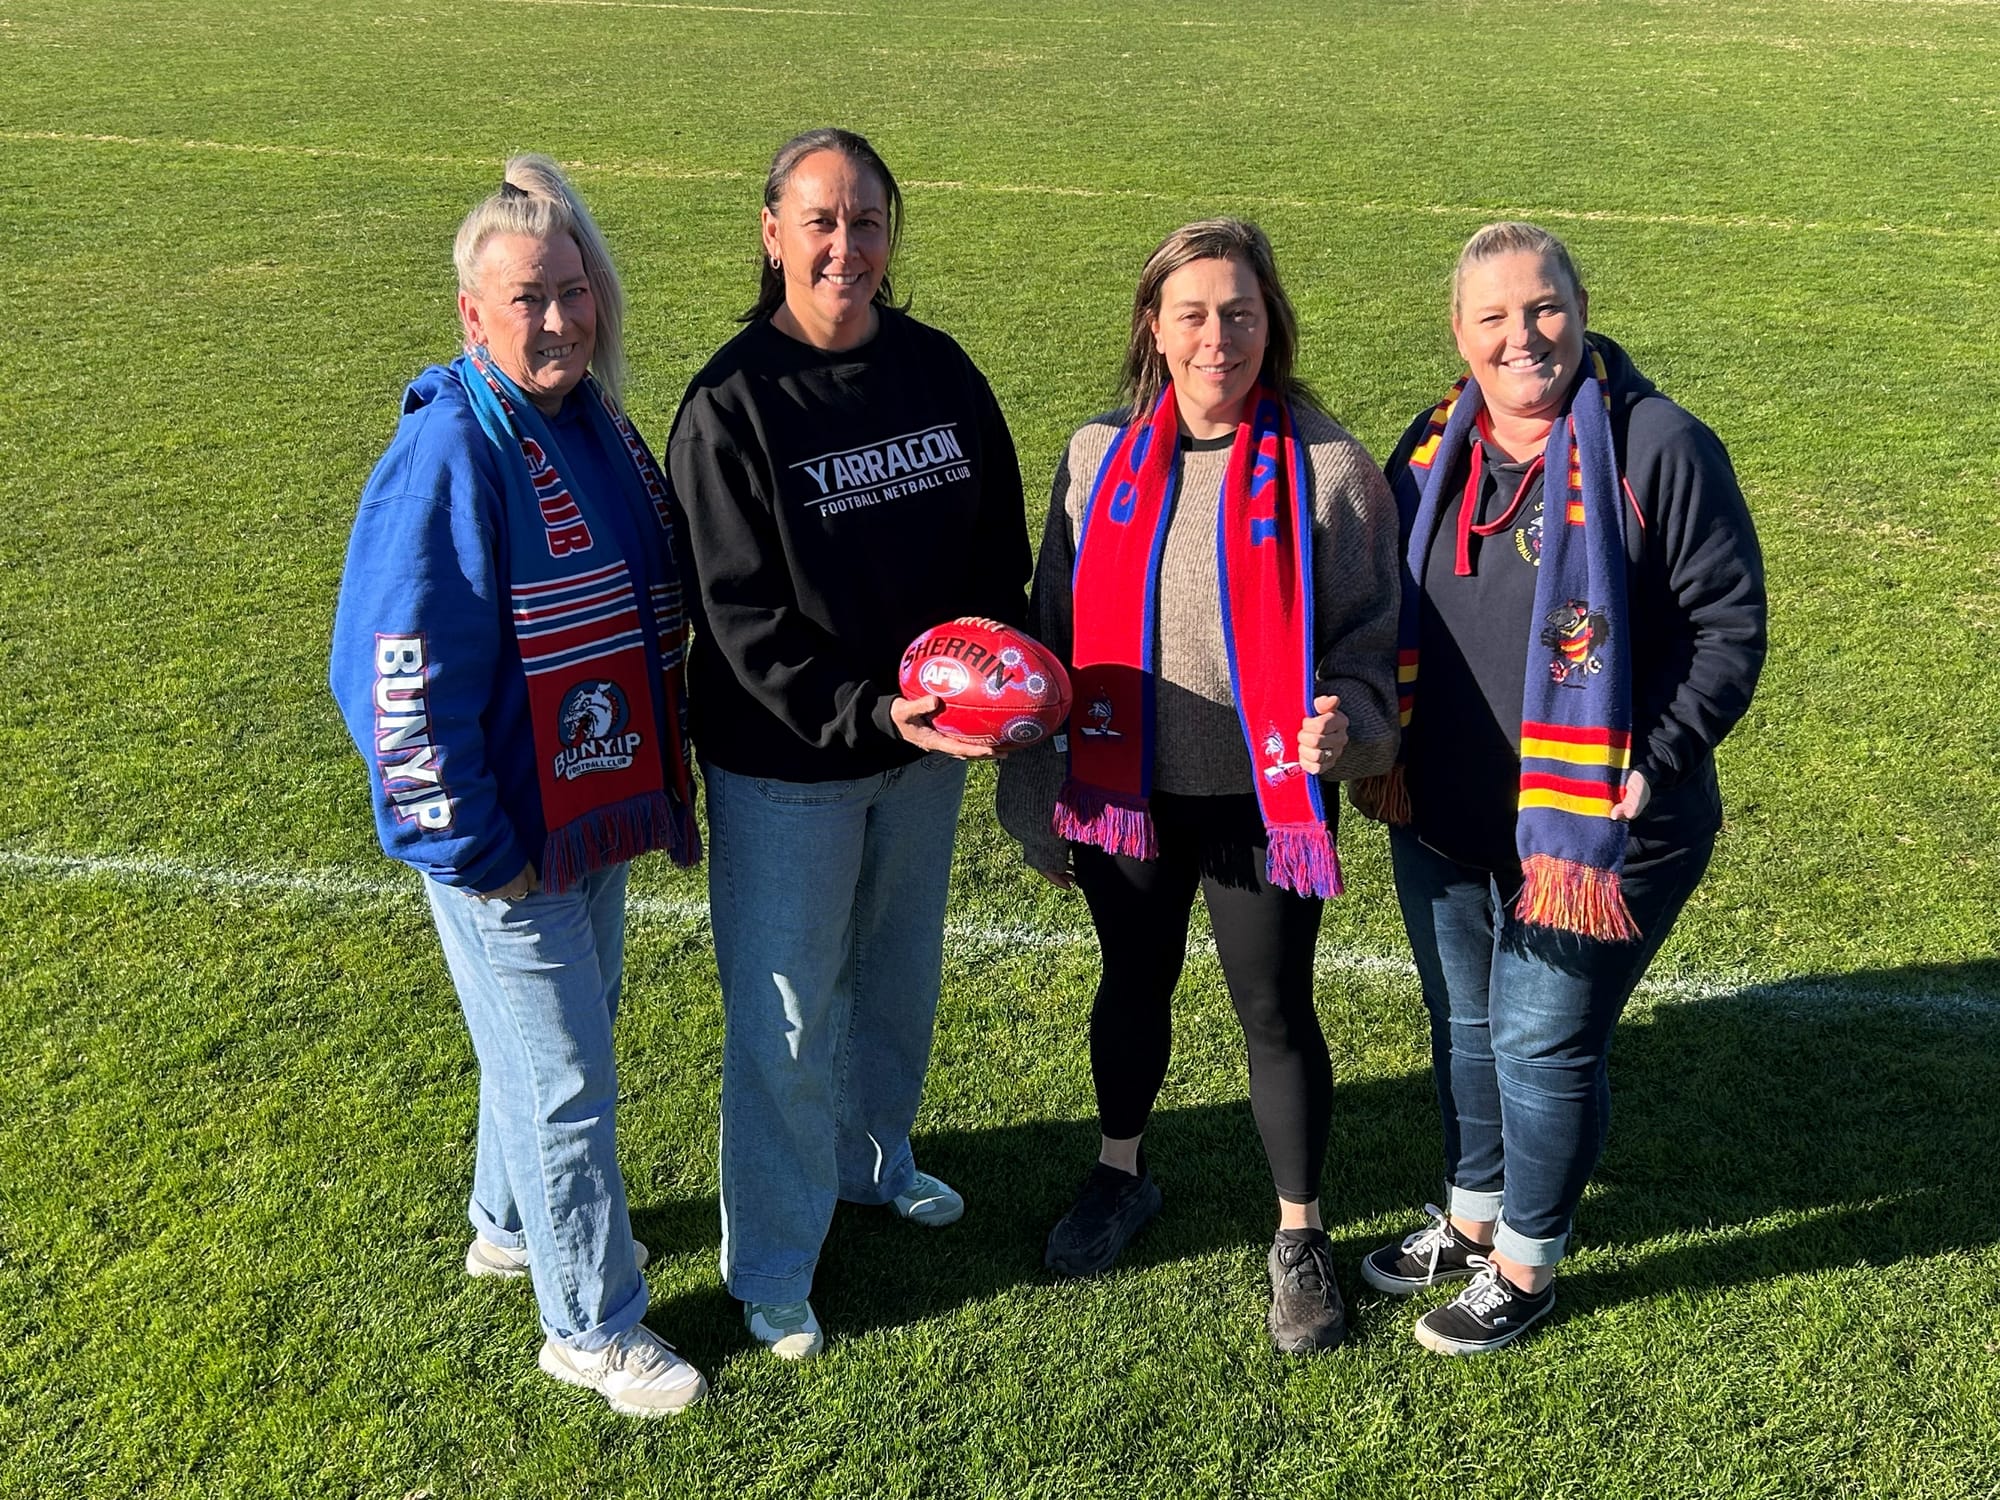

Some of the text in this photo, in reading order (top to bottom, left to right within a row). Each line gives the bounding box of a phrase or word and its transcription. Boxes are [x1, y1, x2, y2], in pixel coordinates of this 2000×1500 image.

[803, 429, 963, 494] YARRAGON
[819, 466, 971, 517] FOOTBALL NETBALL CLUB
[1515, 528, 1533, 562] FOOTBALL
[903, 637, 1015, 690] SHERRIN
[375, 636, 454, 831] BUNYIP
[554, 732, 641, 778] BUNYIP
[568, 757, 627, 776] FOOTBALL CLUB
